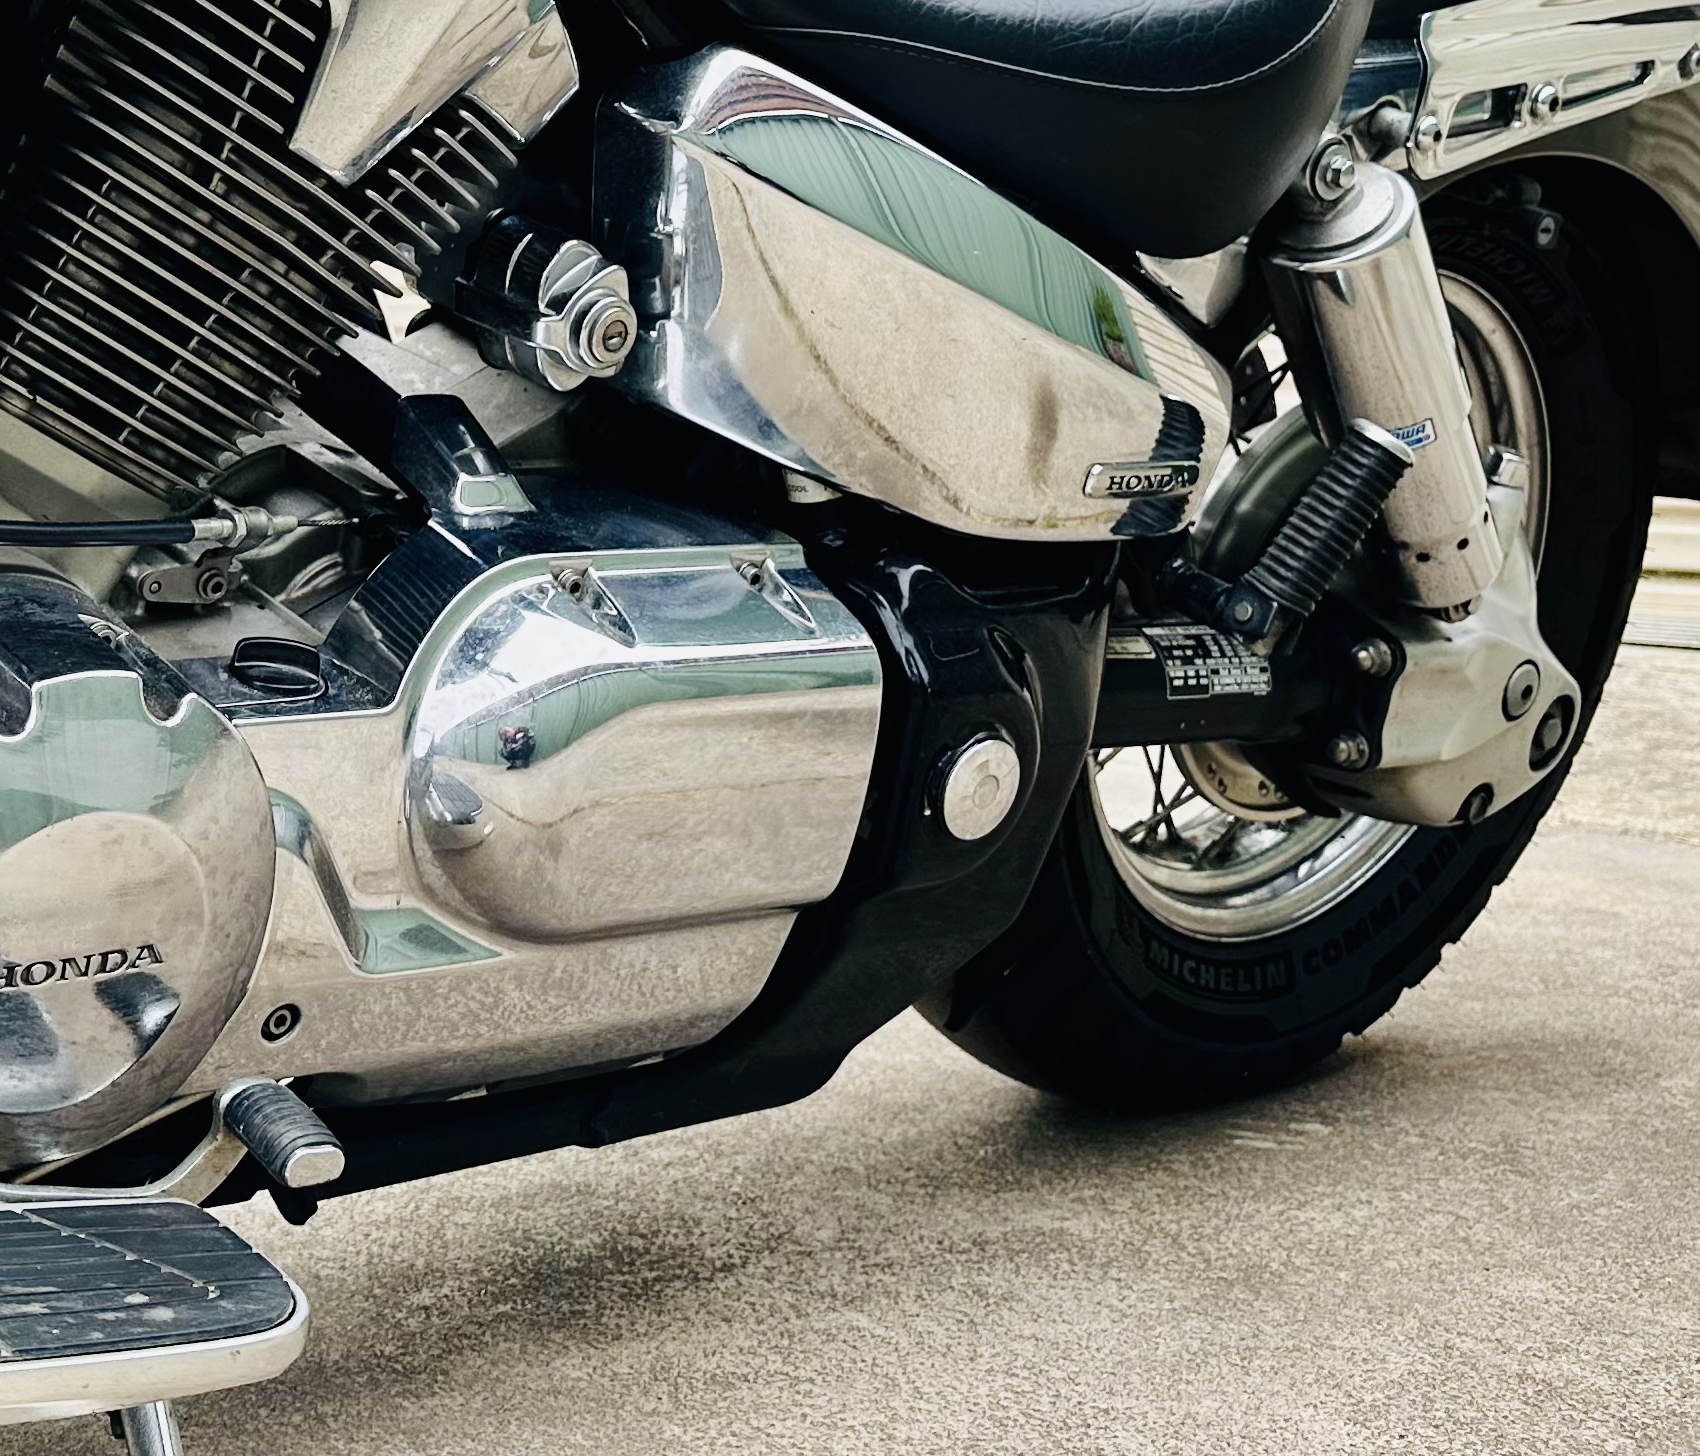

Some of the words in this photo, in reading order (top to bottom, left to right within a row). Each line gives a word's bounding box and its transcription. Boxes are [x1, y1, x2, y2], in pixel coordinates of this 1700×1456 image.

[1105, 473, 1189, 492] HONDA
[1148, 939, 1286, 992] MICHELIN
[1303, 827, 1471, 976] COMMAND
